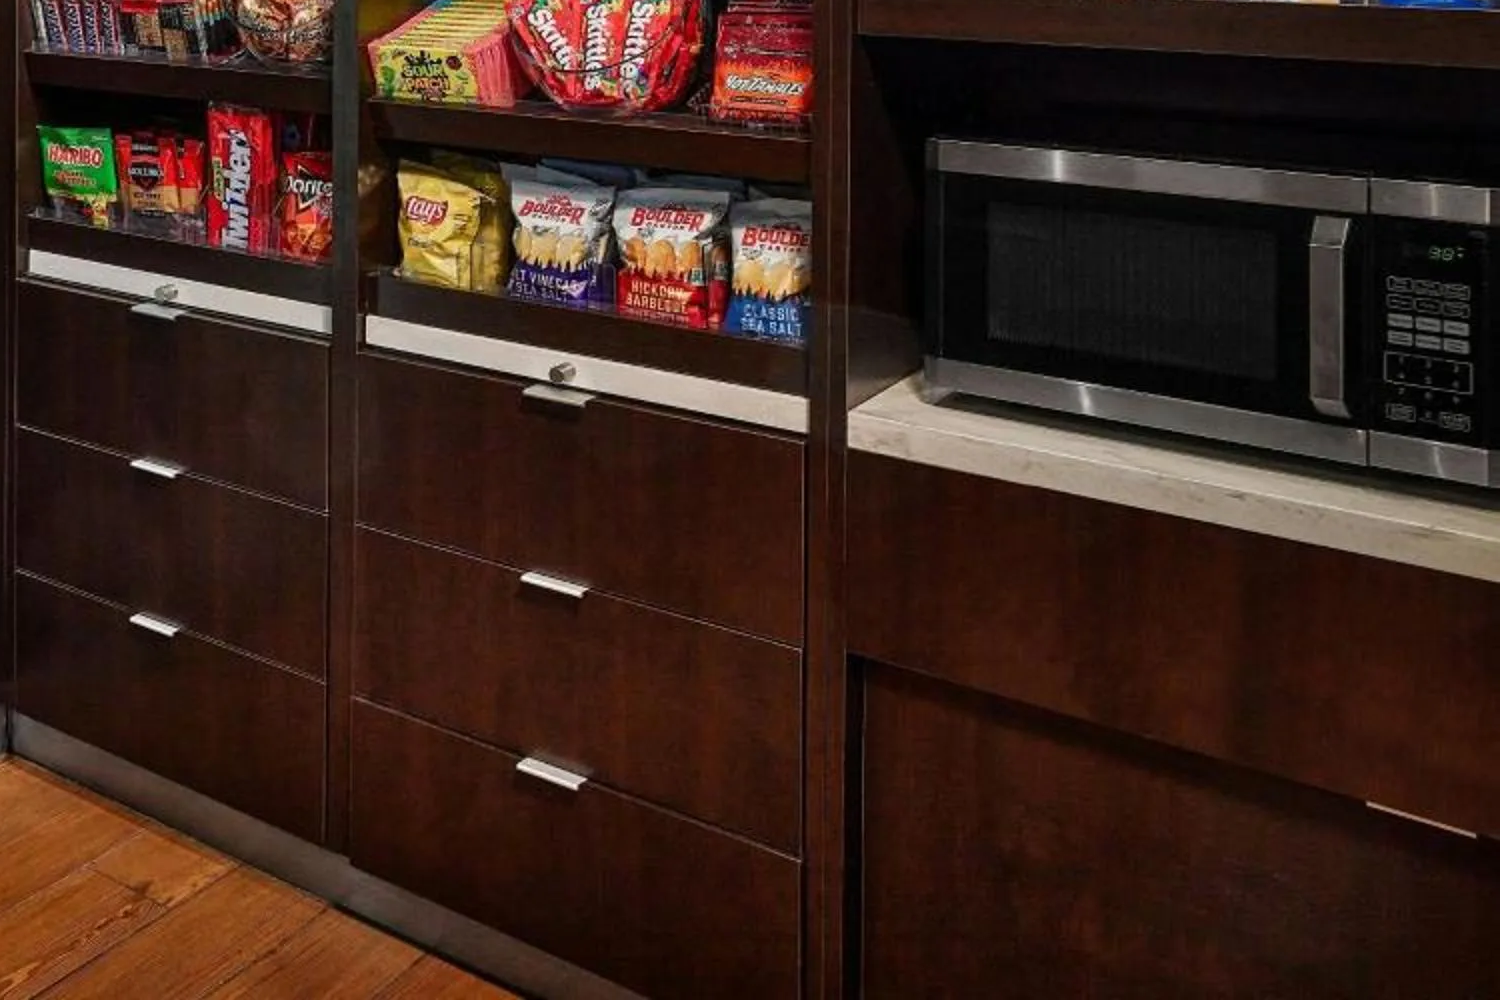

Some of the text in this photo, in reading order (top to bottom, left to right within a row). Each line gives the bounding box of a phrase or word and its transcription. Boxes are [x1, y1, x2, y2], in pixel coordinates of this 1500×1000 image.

[48, 143, 103, 168] HARIBO
[518, 200, 587, 226] BOULDER
[630, 206, 706, 233] BOULDER
[741, 225, 811, 247] BOULDE
[742, 303, 799, 322] CLASSIC
[740, 317, 803, 337] SEA SALT
